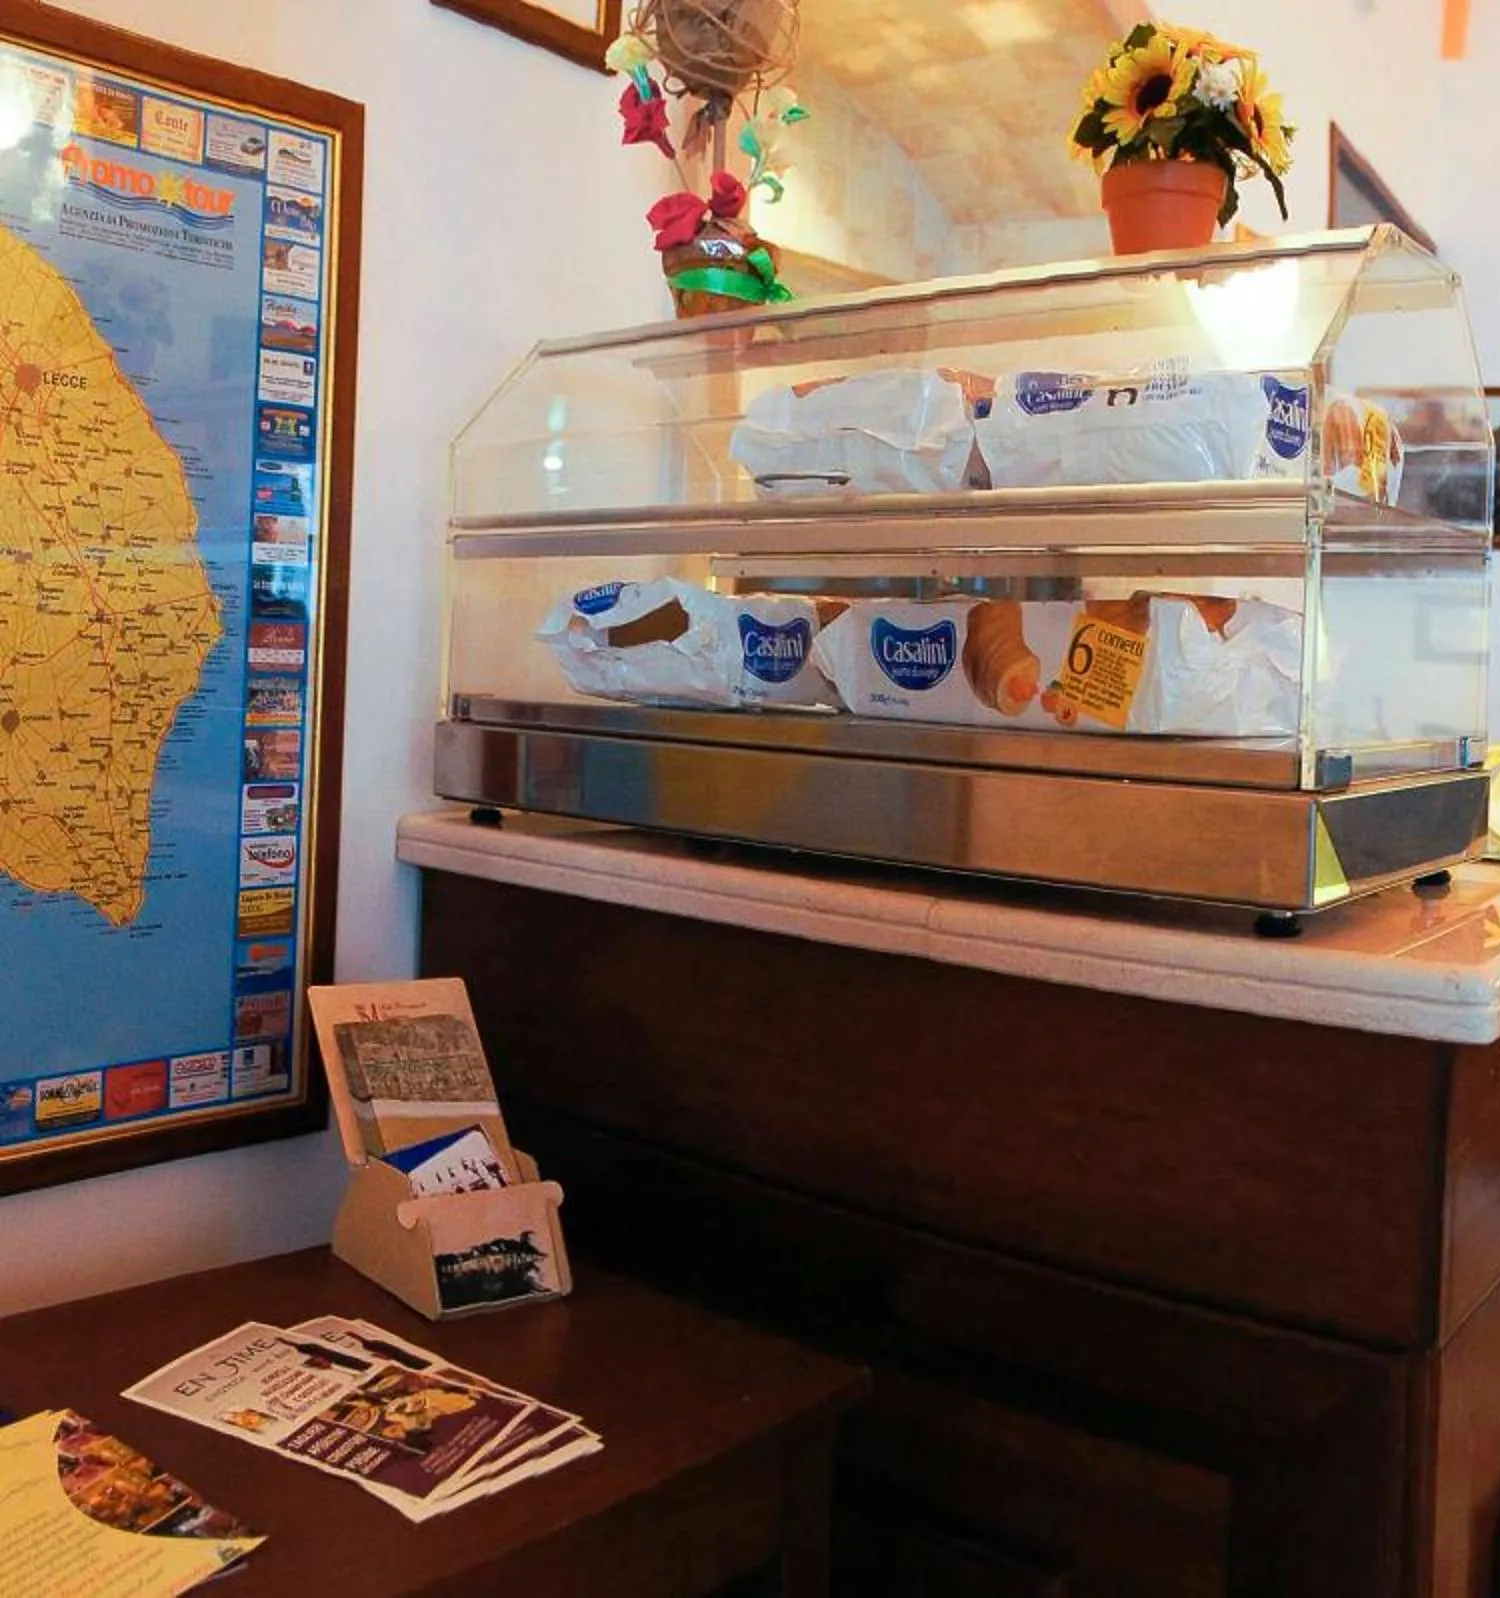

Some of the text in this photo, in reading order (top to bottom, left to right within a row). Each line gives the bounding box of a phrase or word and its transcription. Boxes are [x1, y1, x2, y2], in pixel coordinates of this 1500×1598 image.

[42, 371, 88, 390] LECCE
[744, 630, 804, 658] Casalini
[883, 634, 948, 666] Casalini
[1067, 623, 1146, 675] 6 cornetti
[173, 1373, 217, 1397] EN
